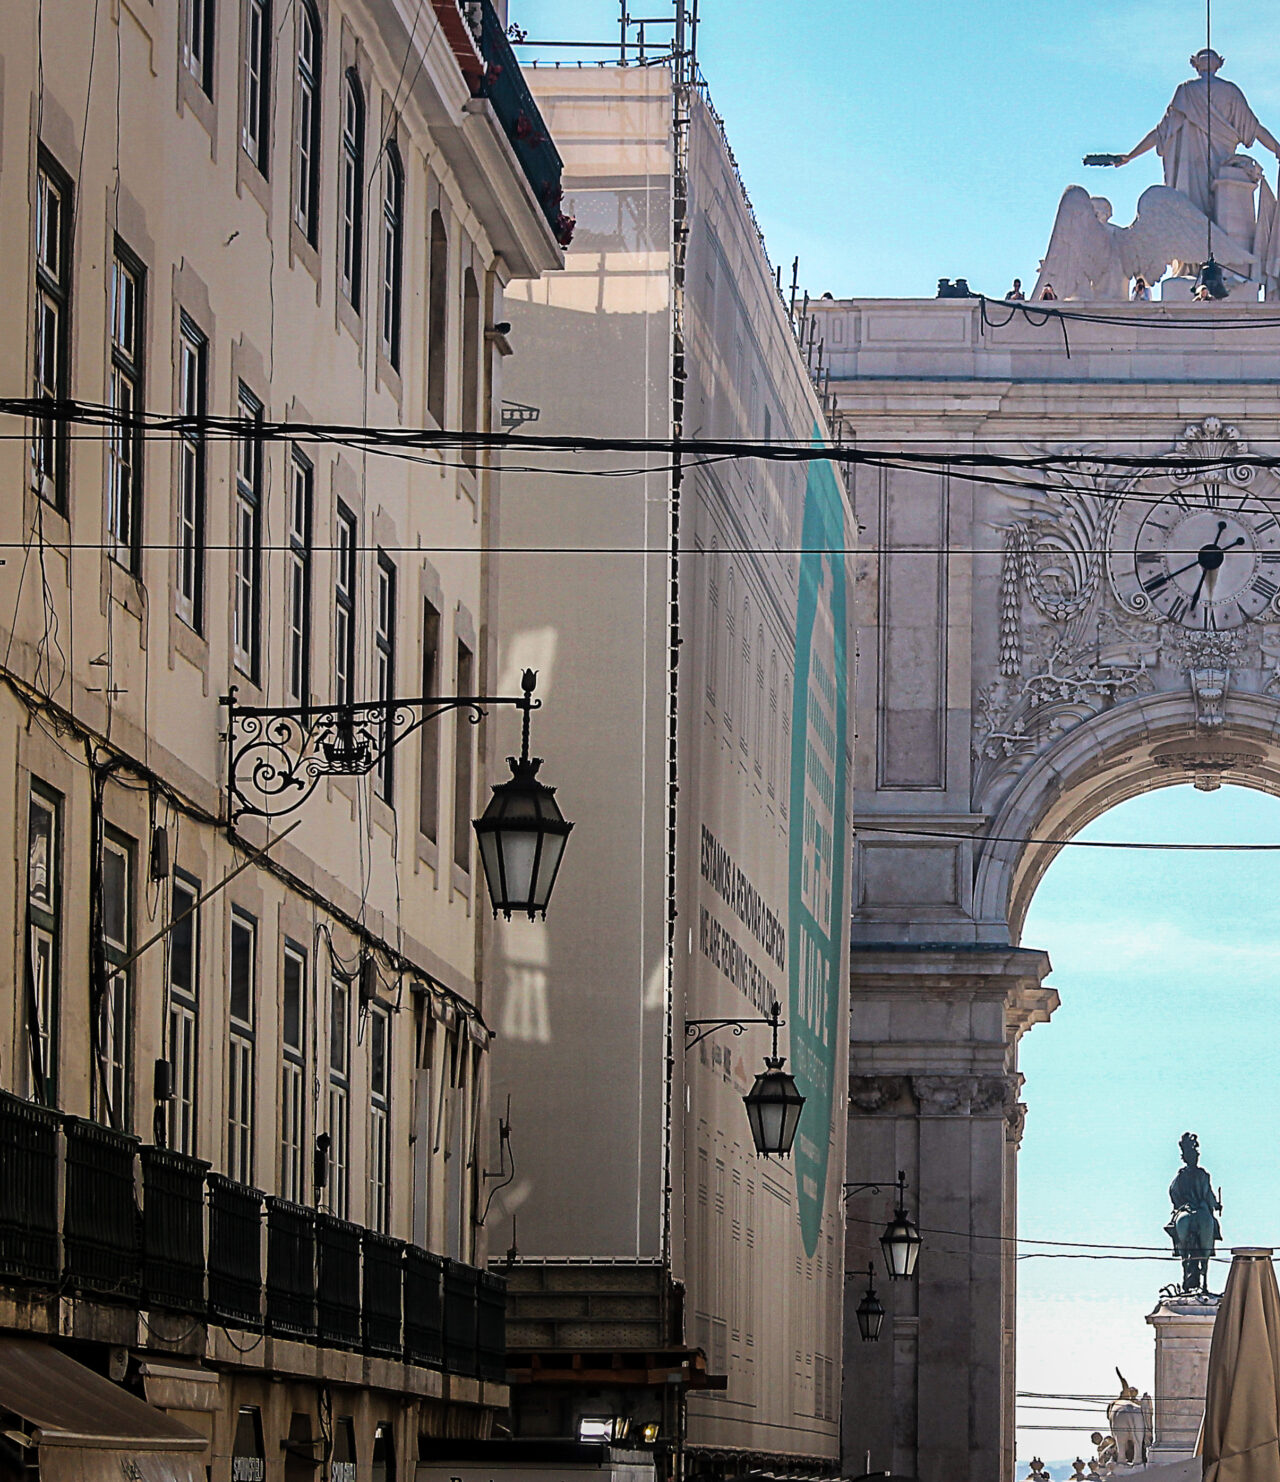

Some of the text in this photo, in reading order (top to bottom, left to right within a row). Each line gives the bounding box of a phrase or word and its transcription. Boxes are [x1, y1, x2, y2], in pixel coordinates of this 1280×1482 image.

[701, 823, 731, 905] ESTAMOS
[736, 868, 761, 943] RENOVAR
[699, 904, 709, 957] WE
[710, 916, 720, 969] ARE
[721, 928, 748, 996] RENEWING
[748, 957, 757, 1007] THE
[798, 924, 830, 1047] MUDE
